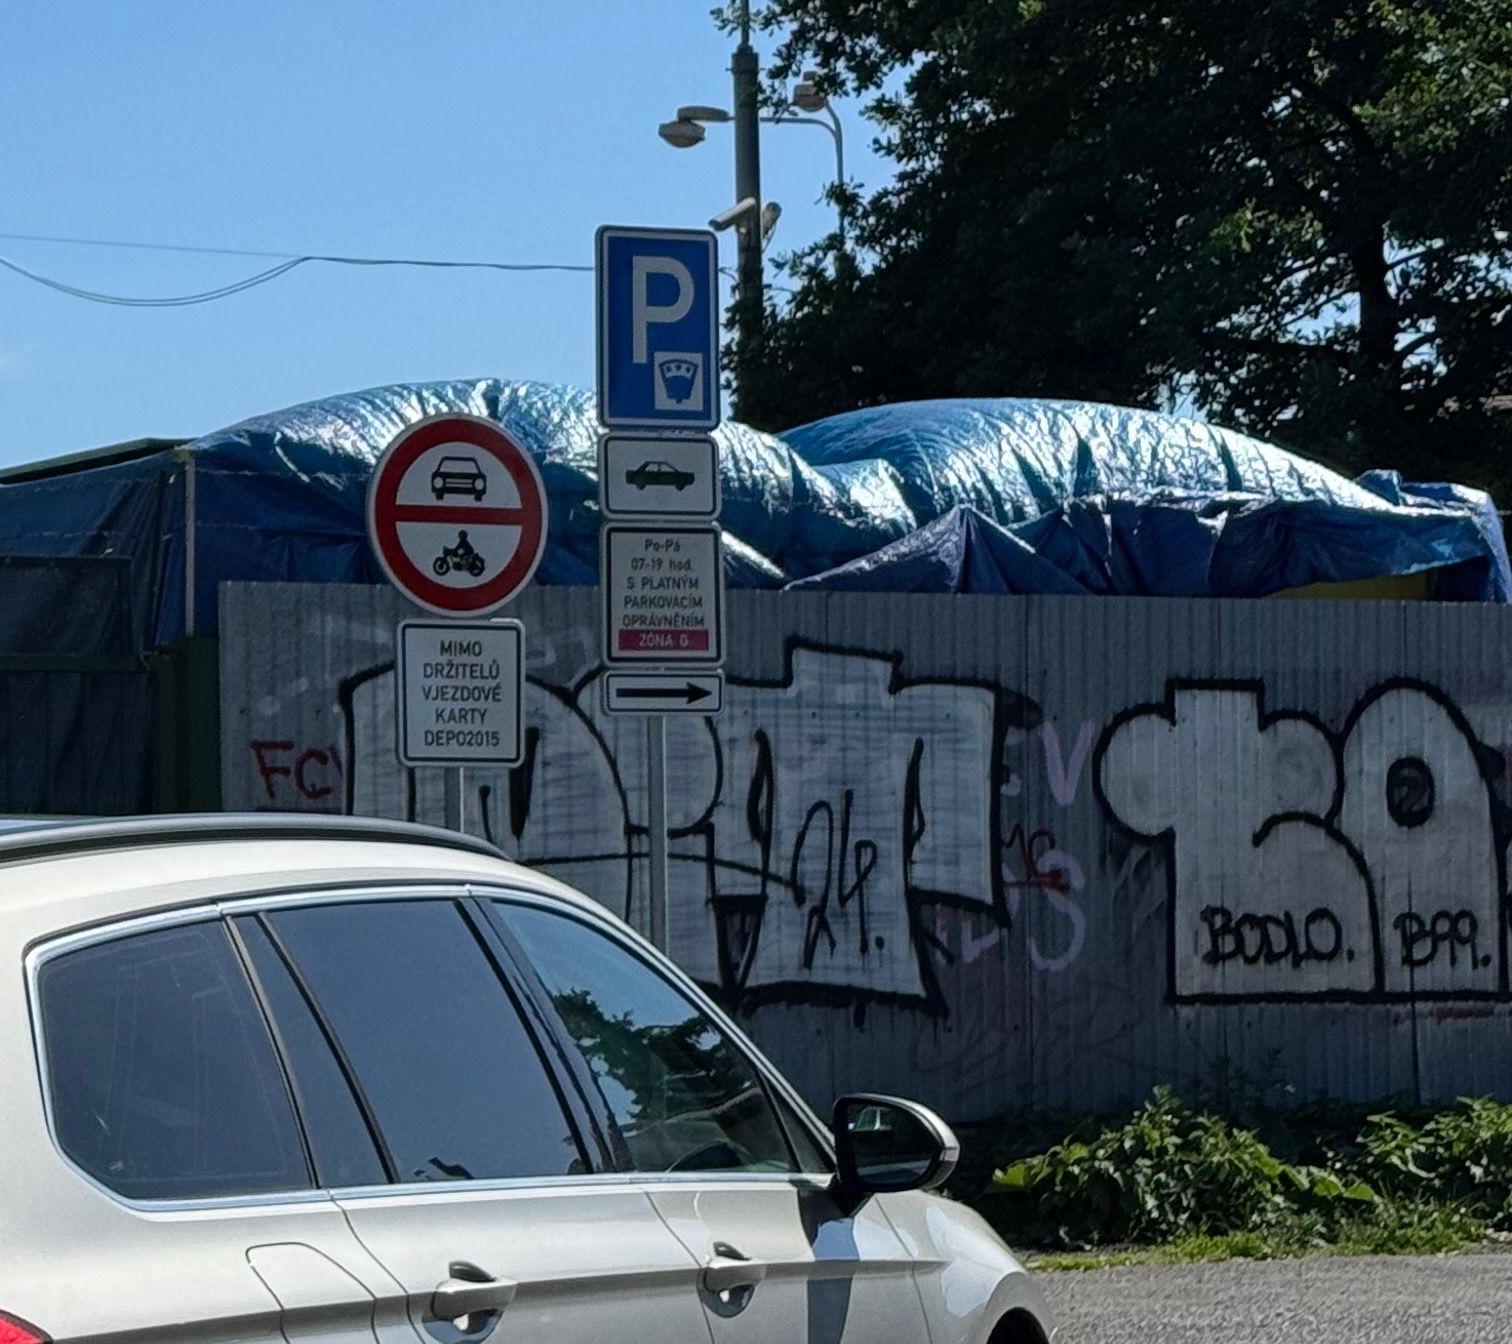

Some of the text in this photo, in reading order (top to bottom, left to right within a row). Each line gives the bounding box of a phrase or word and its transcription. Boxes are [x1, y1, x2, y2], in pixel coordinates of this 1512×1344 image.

[632, 255, 695, 364] P
[631, 557, 663, 571] 07-19
[627, 574, 700, 590] S PLATNÝM
[624, 593, 704, 609] PARKOVACÍM
[622, 611, 705, 628] OPRÁVNĚNÍM
[439, 640, 482, 657] MIMO
[423, 659, 500, 680] DRŽITELŮ
[421, 680, 502, 702] VJEZDOVÉ
[434, 707, 487, 725] KARTY
[424, 730, 500, 747] DEPO2015
